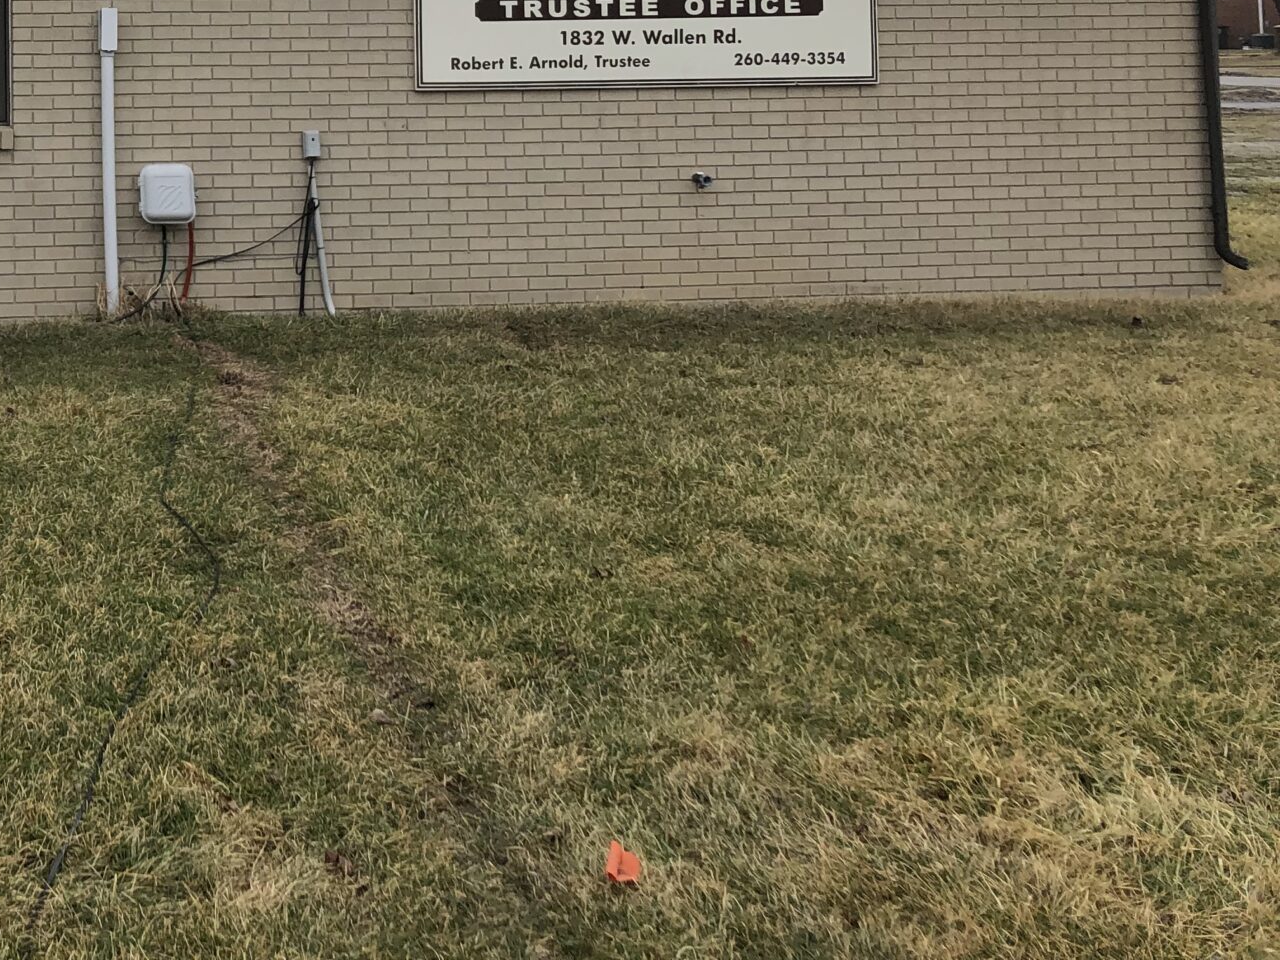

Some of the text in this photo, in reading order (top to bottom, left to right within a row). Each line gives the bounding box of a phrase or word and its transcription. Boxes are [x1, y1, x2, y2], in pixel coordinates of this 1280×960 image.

[560, 27, 742, 46] 1832 W. Wallen Rd.
[450, 54, 651, 71] Robert E. Arnold, Trustee
[733, 51, 846, 66] 260-449-3354
